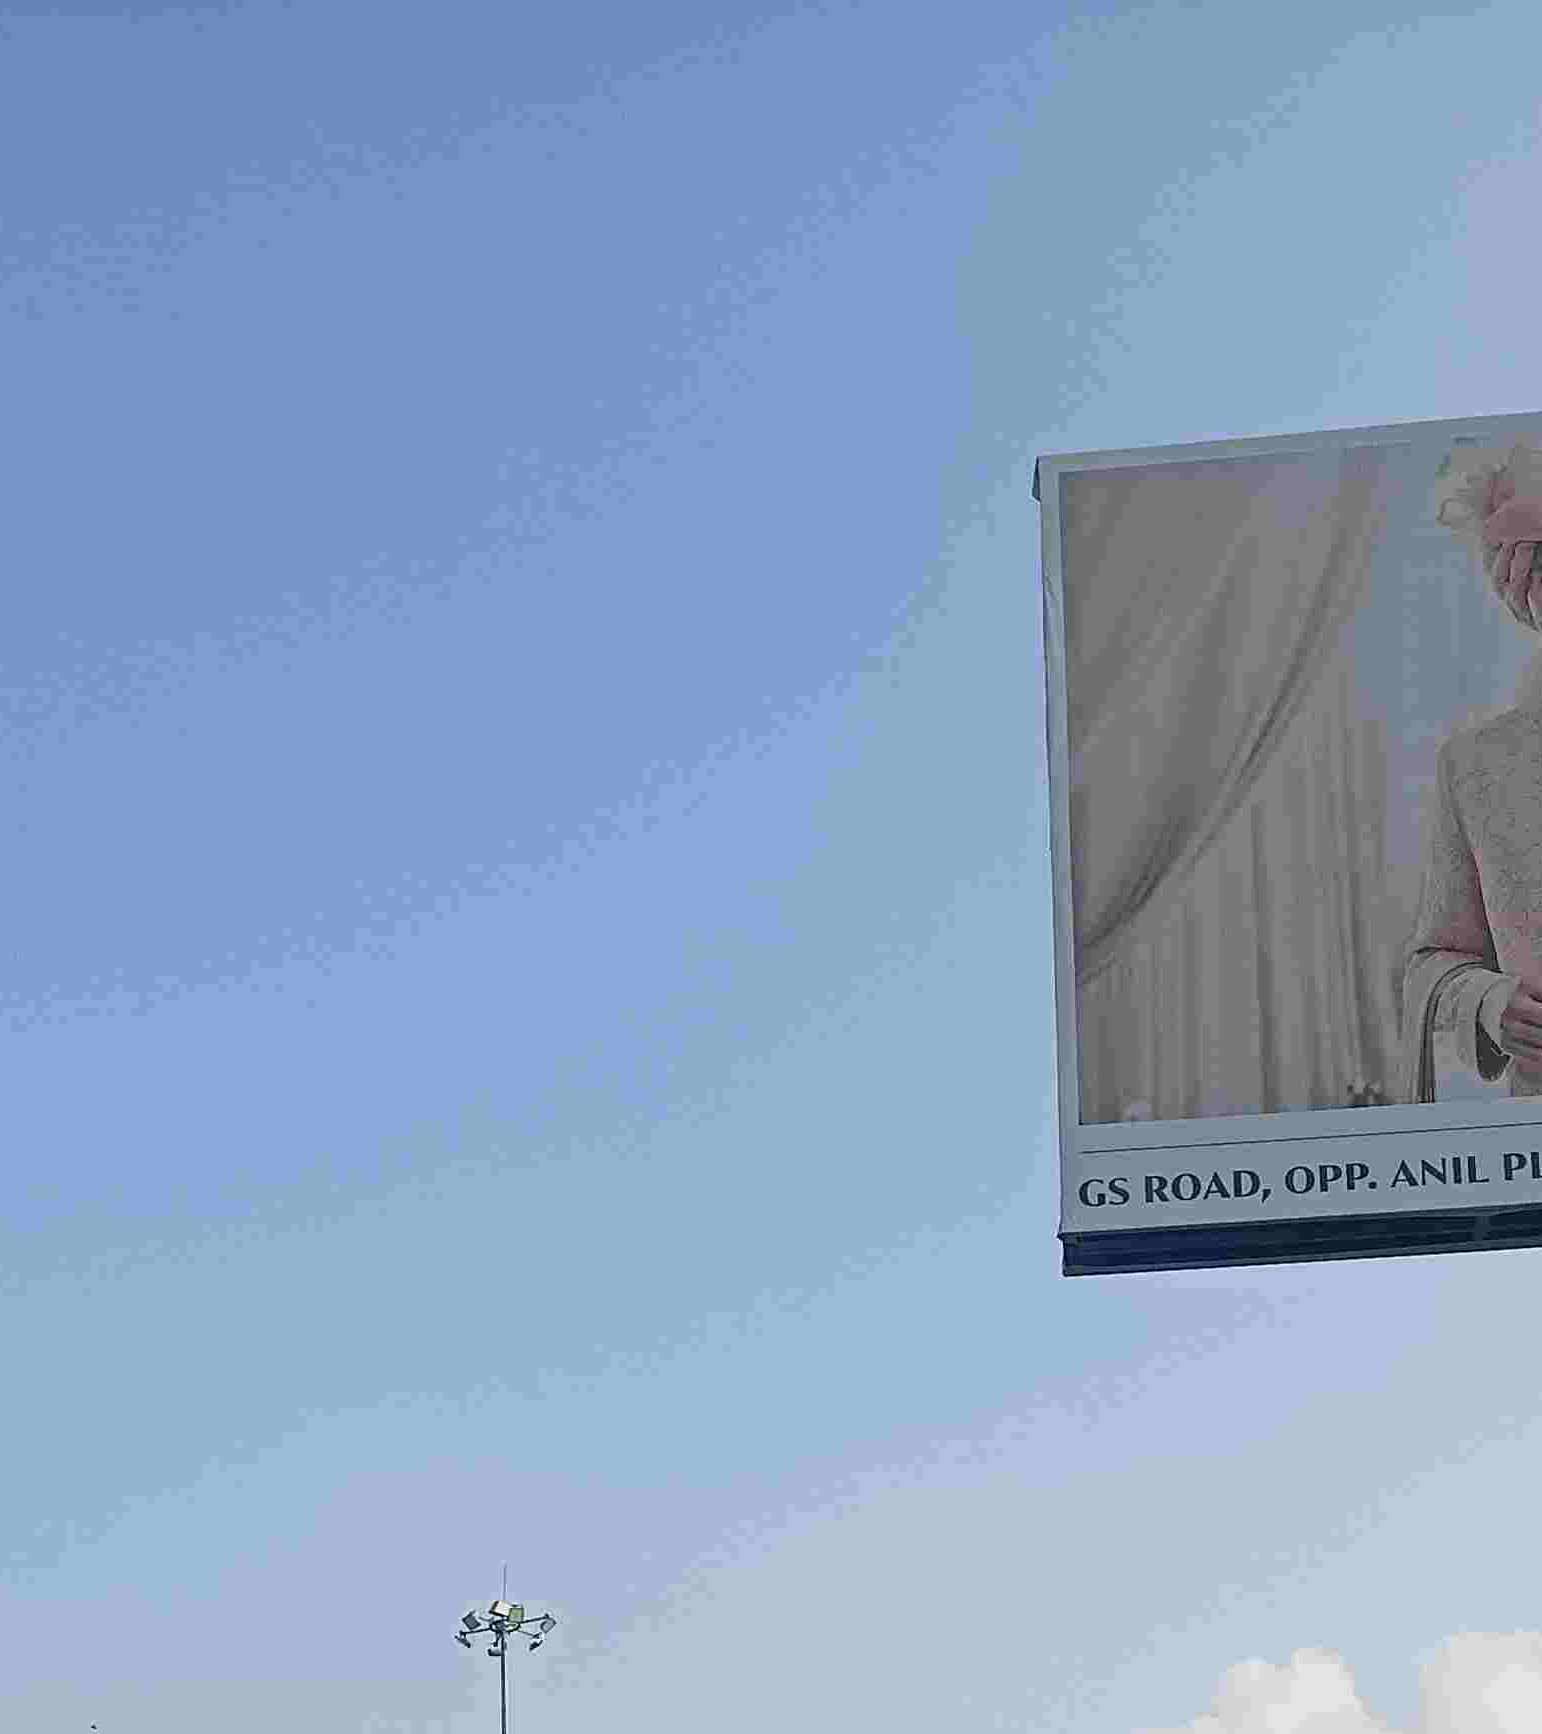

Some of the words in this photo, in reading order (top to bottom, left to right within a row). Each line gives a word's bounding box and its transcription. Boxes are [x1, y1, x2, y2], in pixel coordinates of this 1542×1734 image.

[1078, 1176, 1131, 1208] GS
[1144, 1168, 1272, 1204] ROAD,
[1284, 1162, 1378, 1196] OPP.
[1390, 1154, 1490, 1189] ANIL
